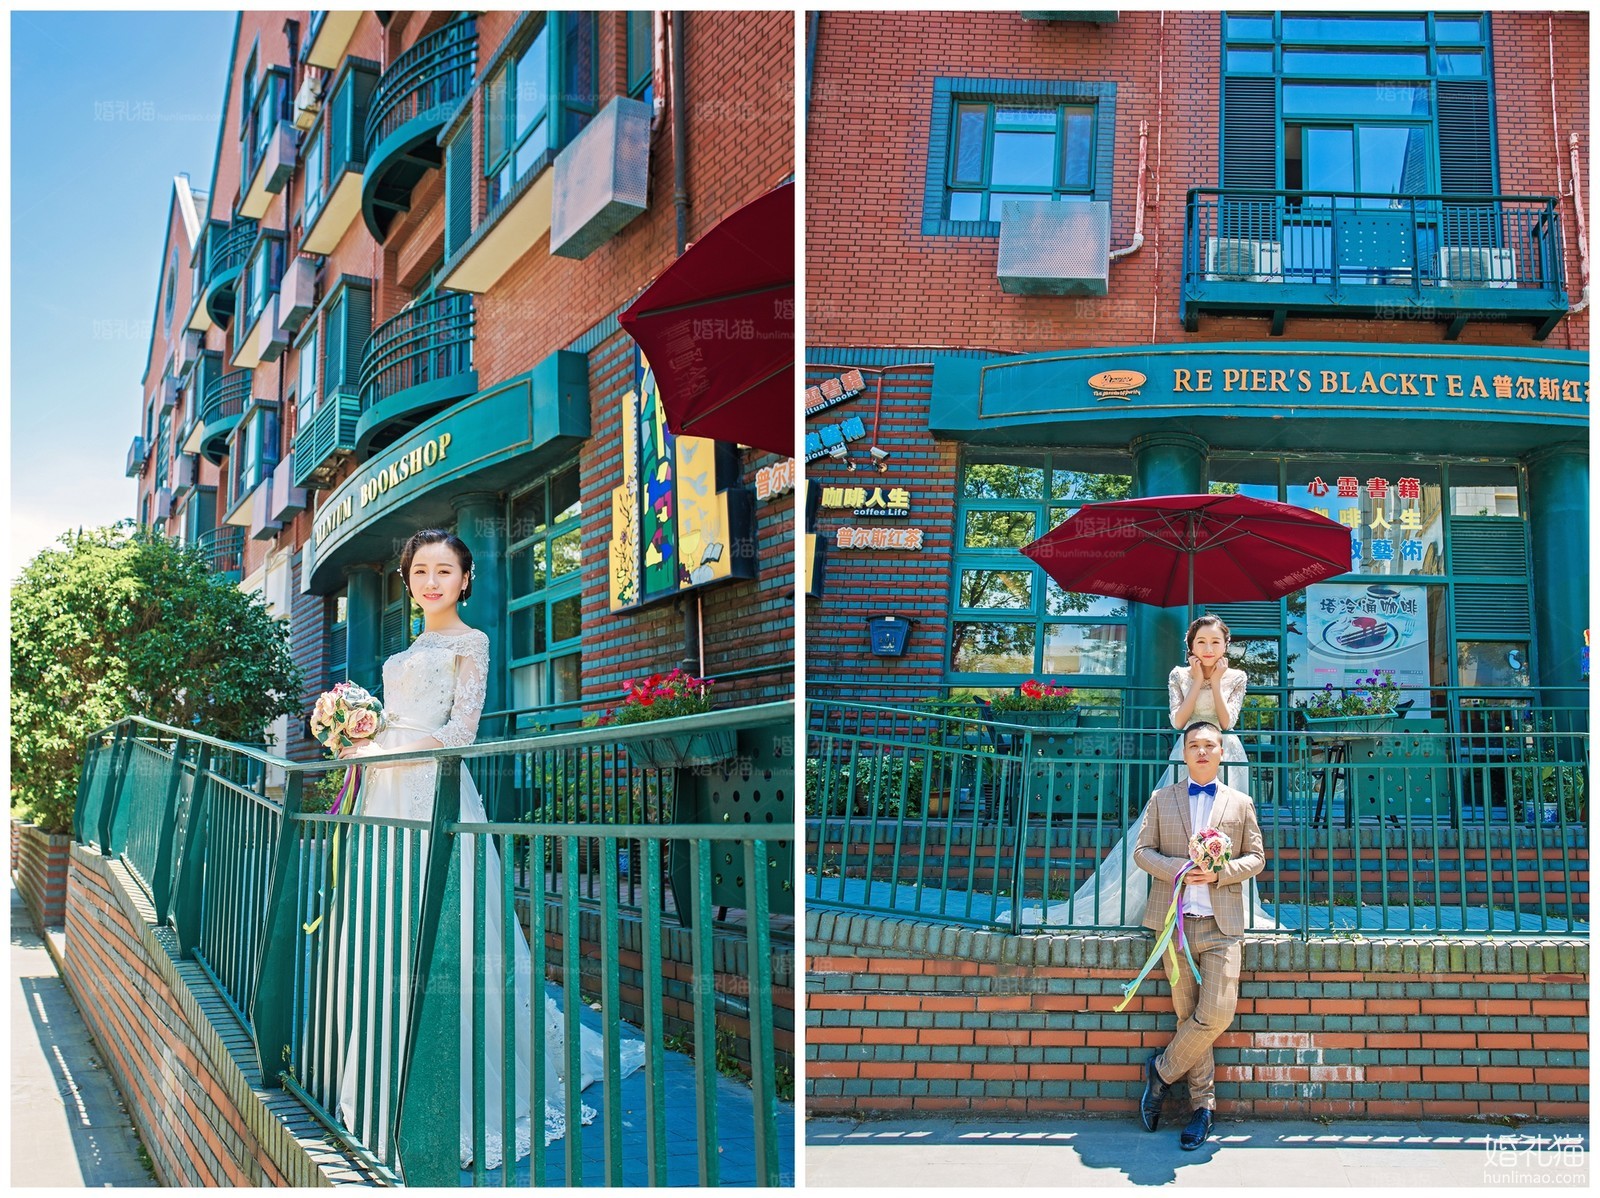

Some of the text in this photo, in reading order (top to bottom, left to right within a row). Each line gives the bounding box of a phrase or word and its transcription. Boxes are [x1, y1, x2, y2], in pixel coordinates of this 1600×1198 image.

[1173, 368, 1212, 392] RE
[1223, 368, 1312, 393] PIER'S
[829, 389, 859, 406] books
[360, 432, 453, 509] BOOKSHOP
[822, 487, 911, 509] 咖啡人生
[1307, 476, 1421, 499] 心靈書籍
[853, 508, 908, 516] coffee Life
[837, 527, 924, 551] 普尔斯红茶
[1320, 597, 1418, 615] 塔冷通咖啡
